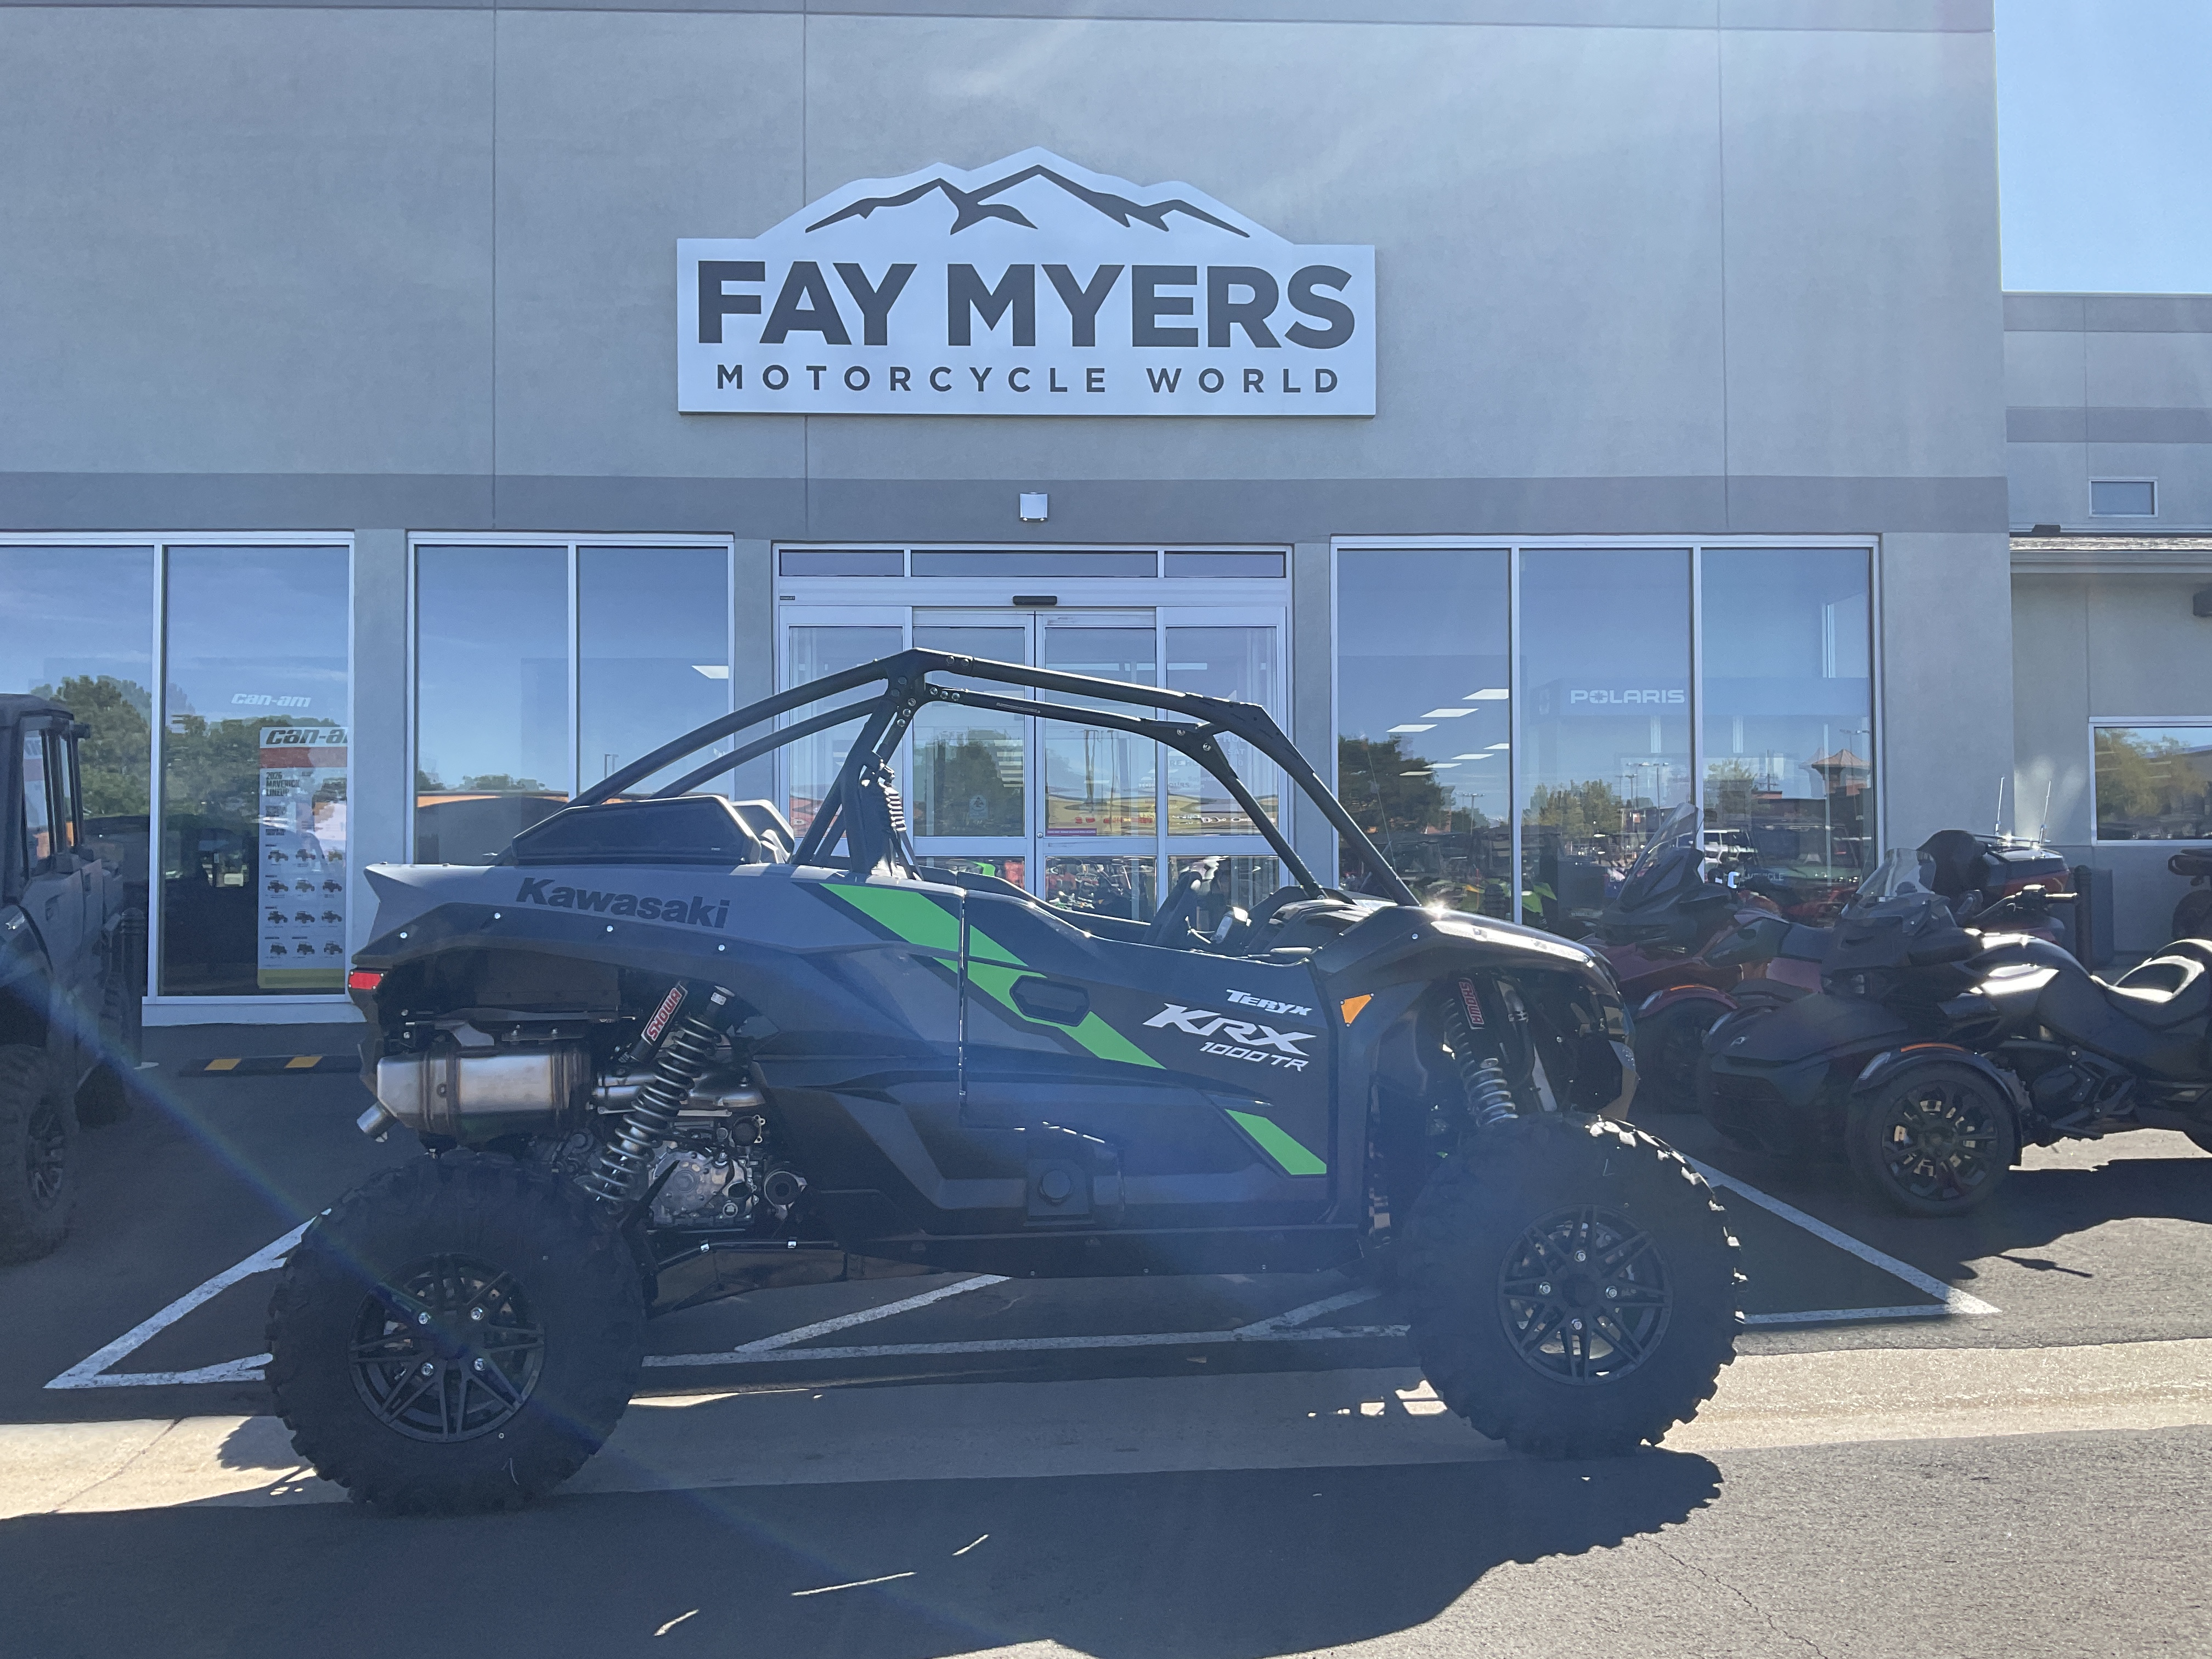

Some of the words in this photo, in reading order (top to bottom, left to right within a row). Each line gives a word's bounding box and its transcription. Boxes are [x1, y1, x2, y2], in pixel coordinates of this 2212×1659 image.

[698, 260, 917, 346] FAY
[947, 263, 1355, 349] MYERS
[716, 364, 1106, 393] MOTORCYCLE
[1146, 367, 1339, 393] WORLD
[231, 693, 311, 708] can-am
[1570, 689, 1685, 704] POLARIS
[266, 729, 348, 745] can-a
[515, 877, 731, 929] Kawasaki
[646, 987, 682, 1041] SHOWA
[1458, 981, 1485, 1025] SHOWA
[1142, 1003, 1317, 1056] KRX
[1199, 1042, 1269, 1062] 1000
[1270, 1054, 1309, 1071] TR
